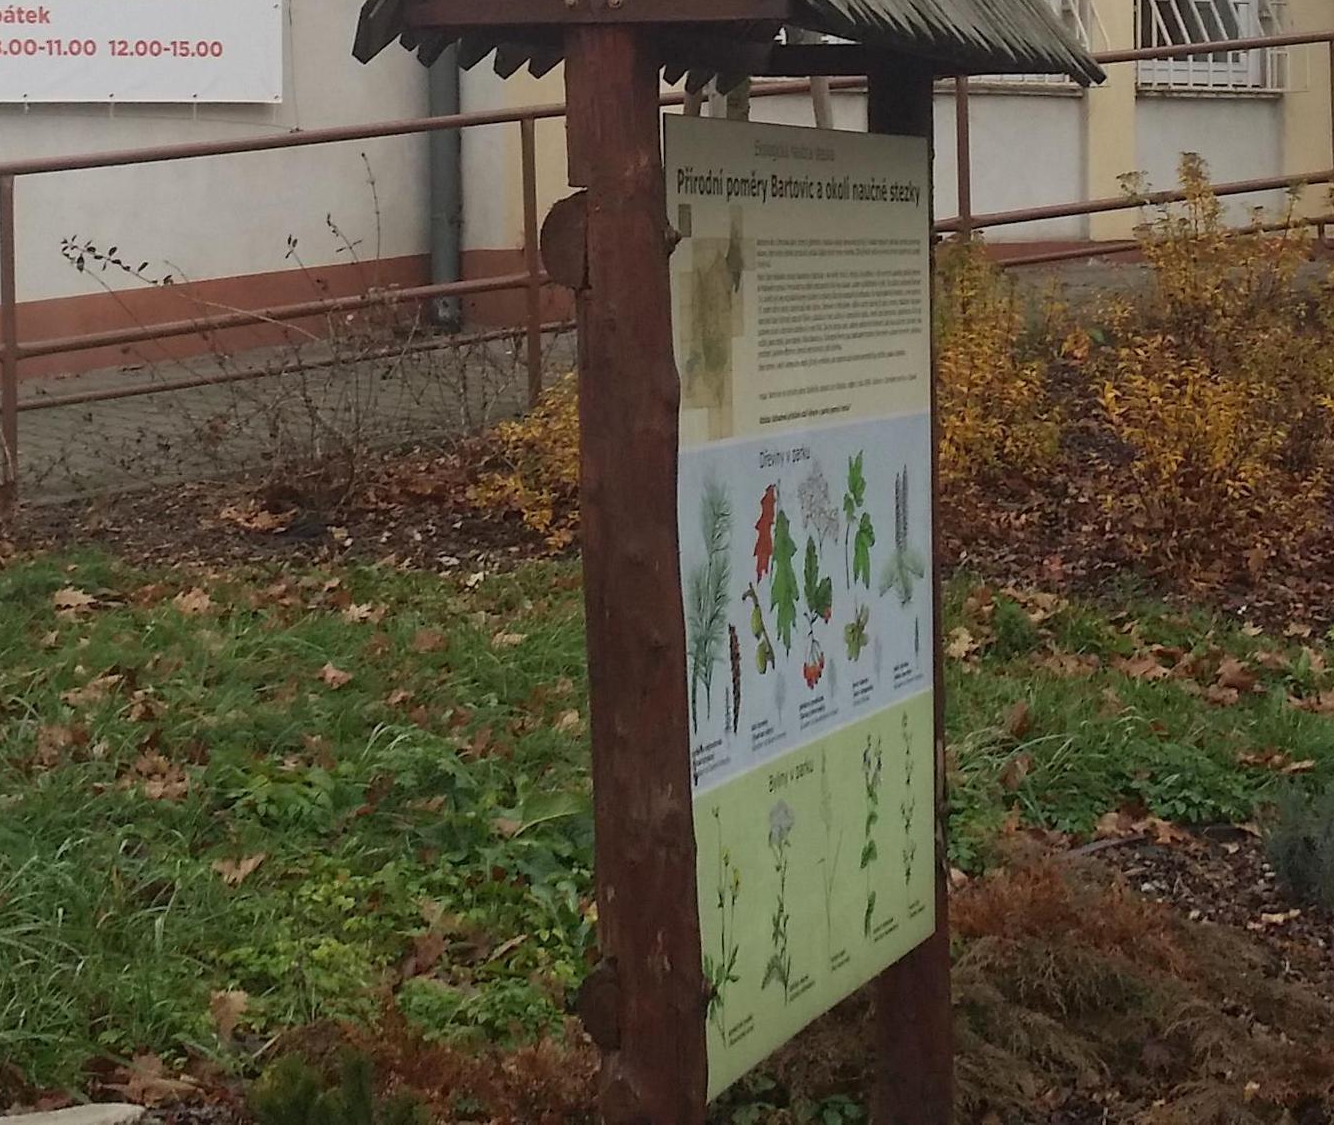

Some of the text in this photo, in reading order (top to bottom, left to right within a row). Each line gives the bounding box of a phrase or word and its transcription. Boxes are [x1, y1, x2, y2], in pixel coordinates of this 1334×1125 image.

[107, 39, 224, 59] 12.00-15.00
[677, 167, 724, 196] Přírodní
[726, 169, 768, 203] poměry
[771, 174, 814, 199] Bartovic
[816, 181, 823, 200] a
[890, 179, 920, 209] stezky
